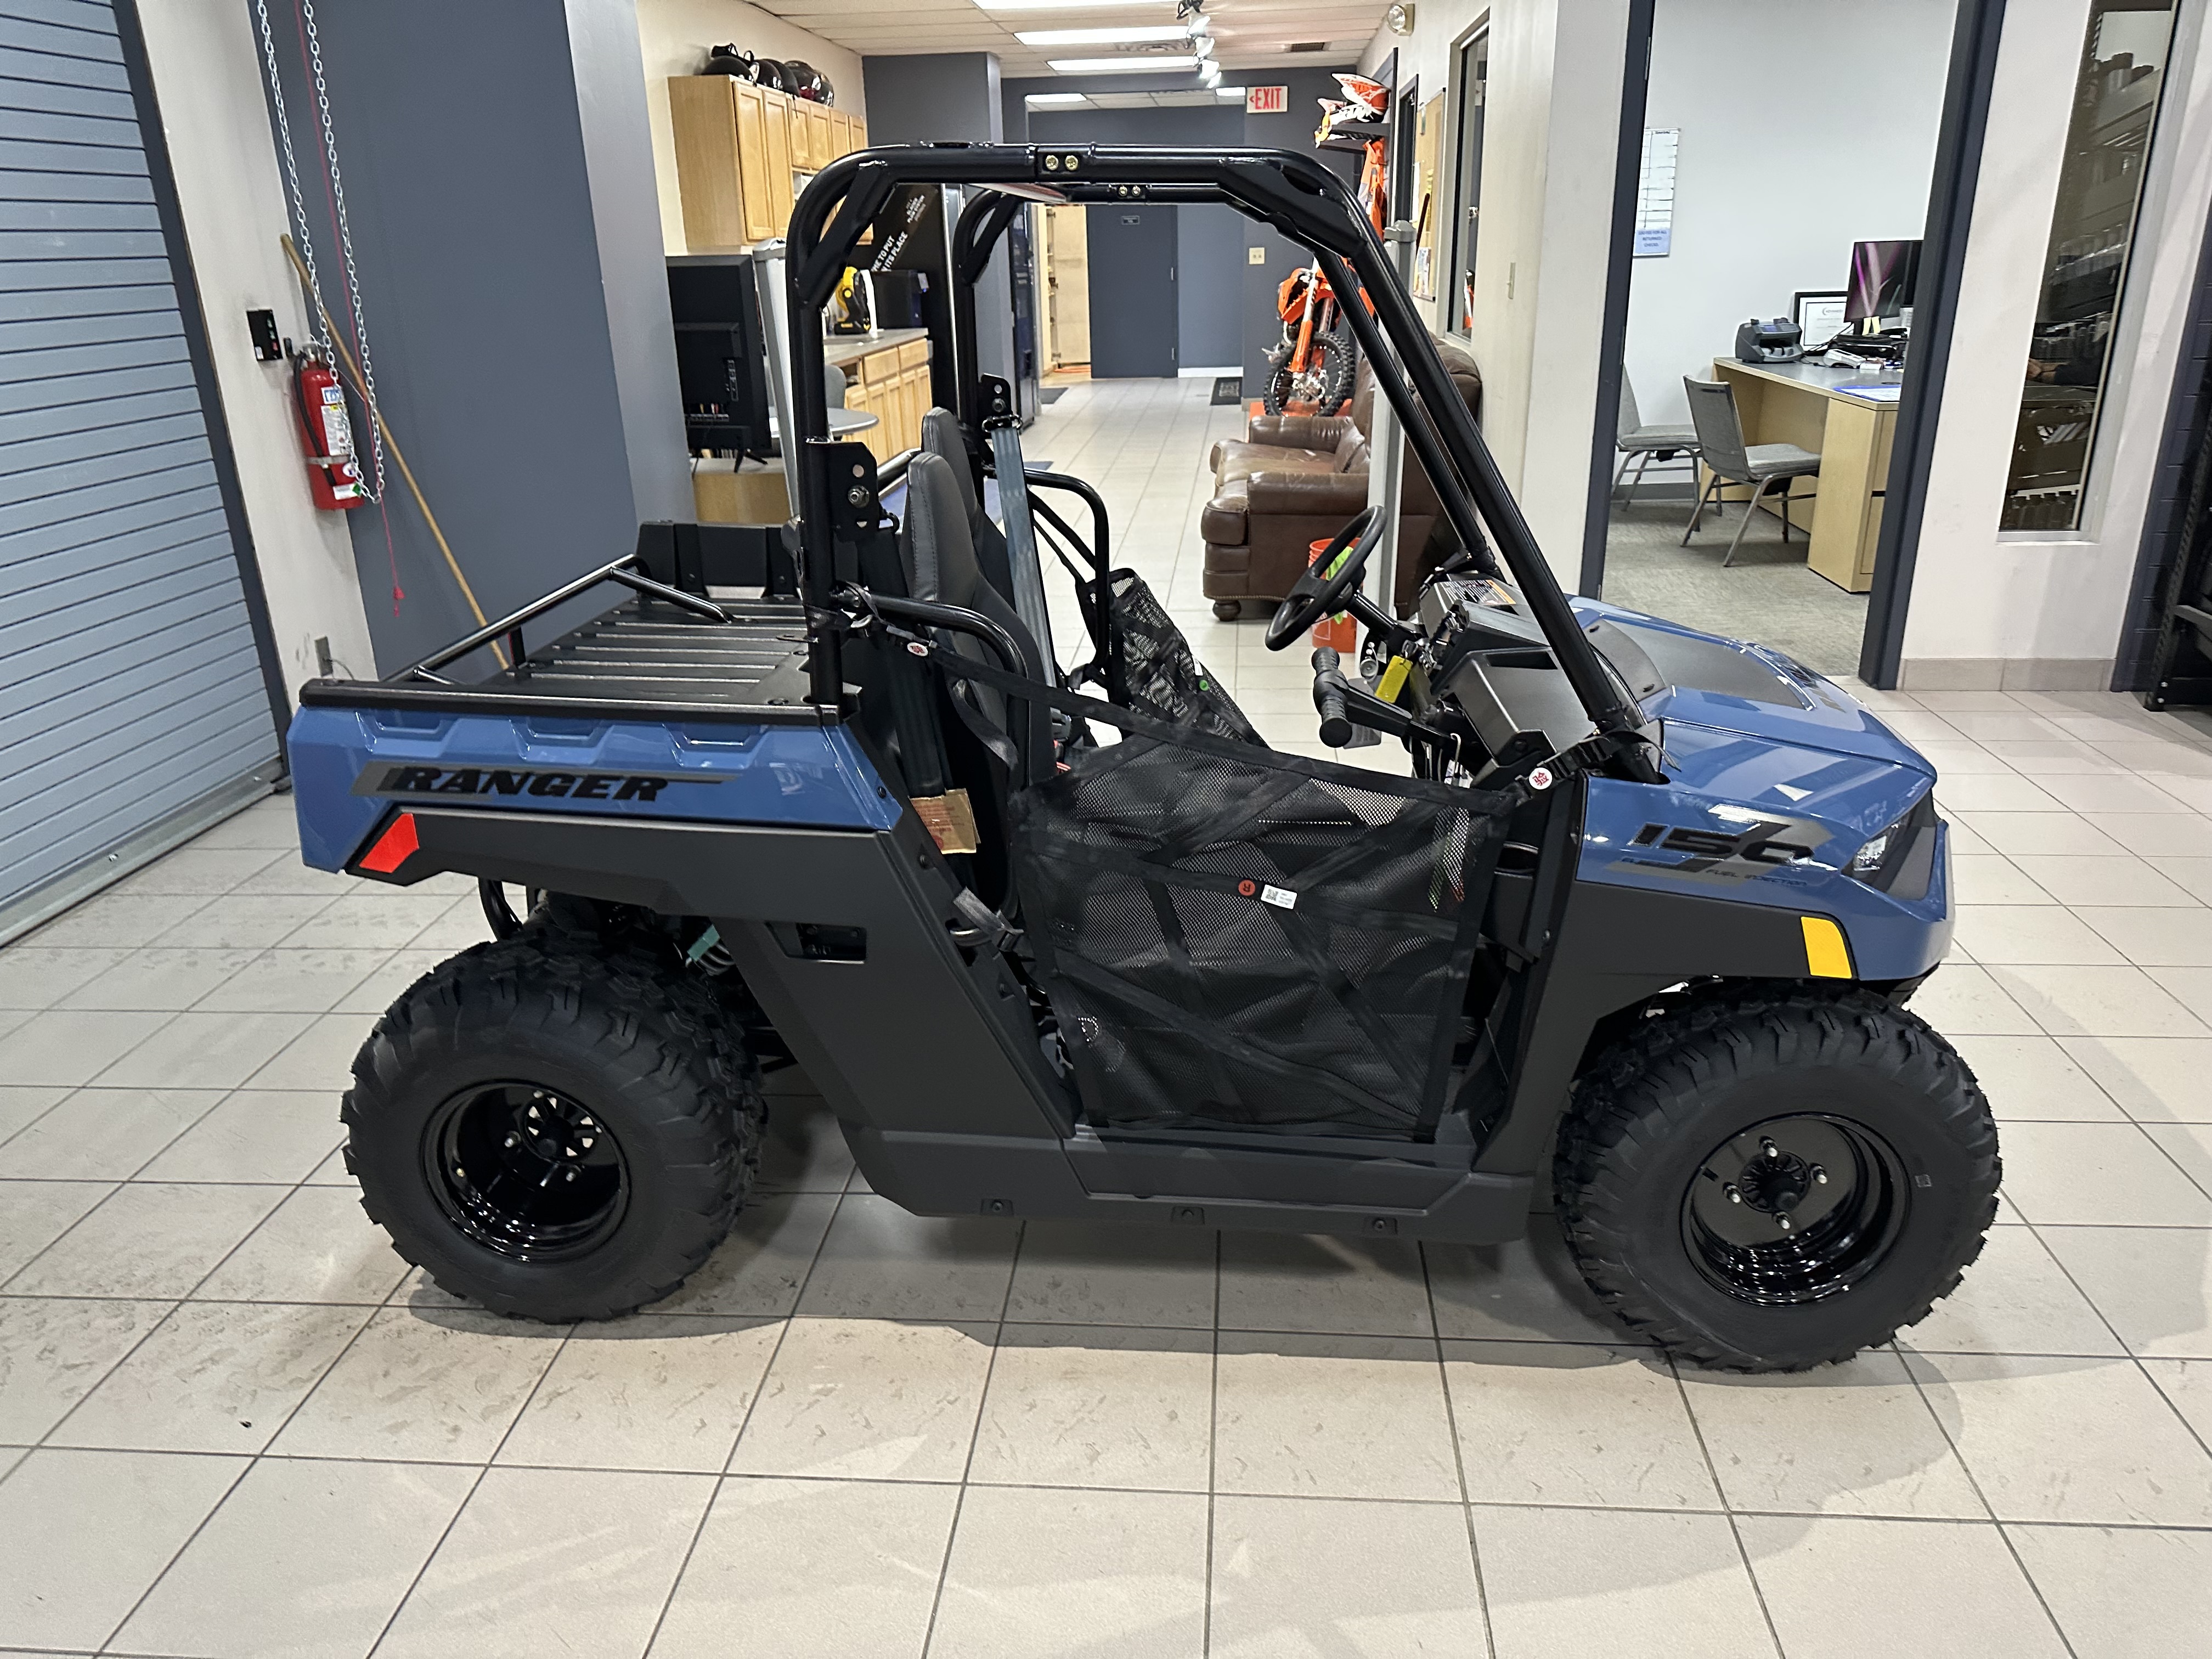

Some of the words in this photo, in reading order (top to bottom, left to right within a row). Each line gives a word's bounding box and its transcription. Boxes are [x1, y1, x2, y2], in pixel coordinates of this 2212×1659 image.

[1255, 88, 1282, 109] EXIT
[878, 249, 887, 261] TO
[883, 235, 895, 252] PUT
[884, 255, 895, 268] ITS
[890, 231, 908, 256] PLACE
[386, 766, 669, 802] RANGER
[1626, 822, 1815, 866] 150
